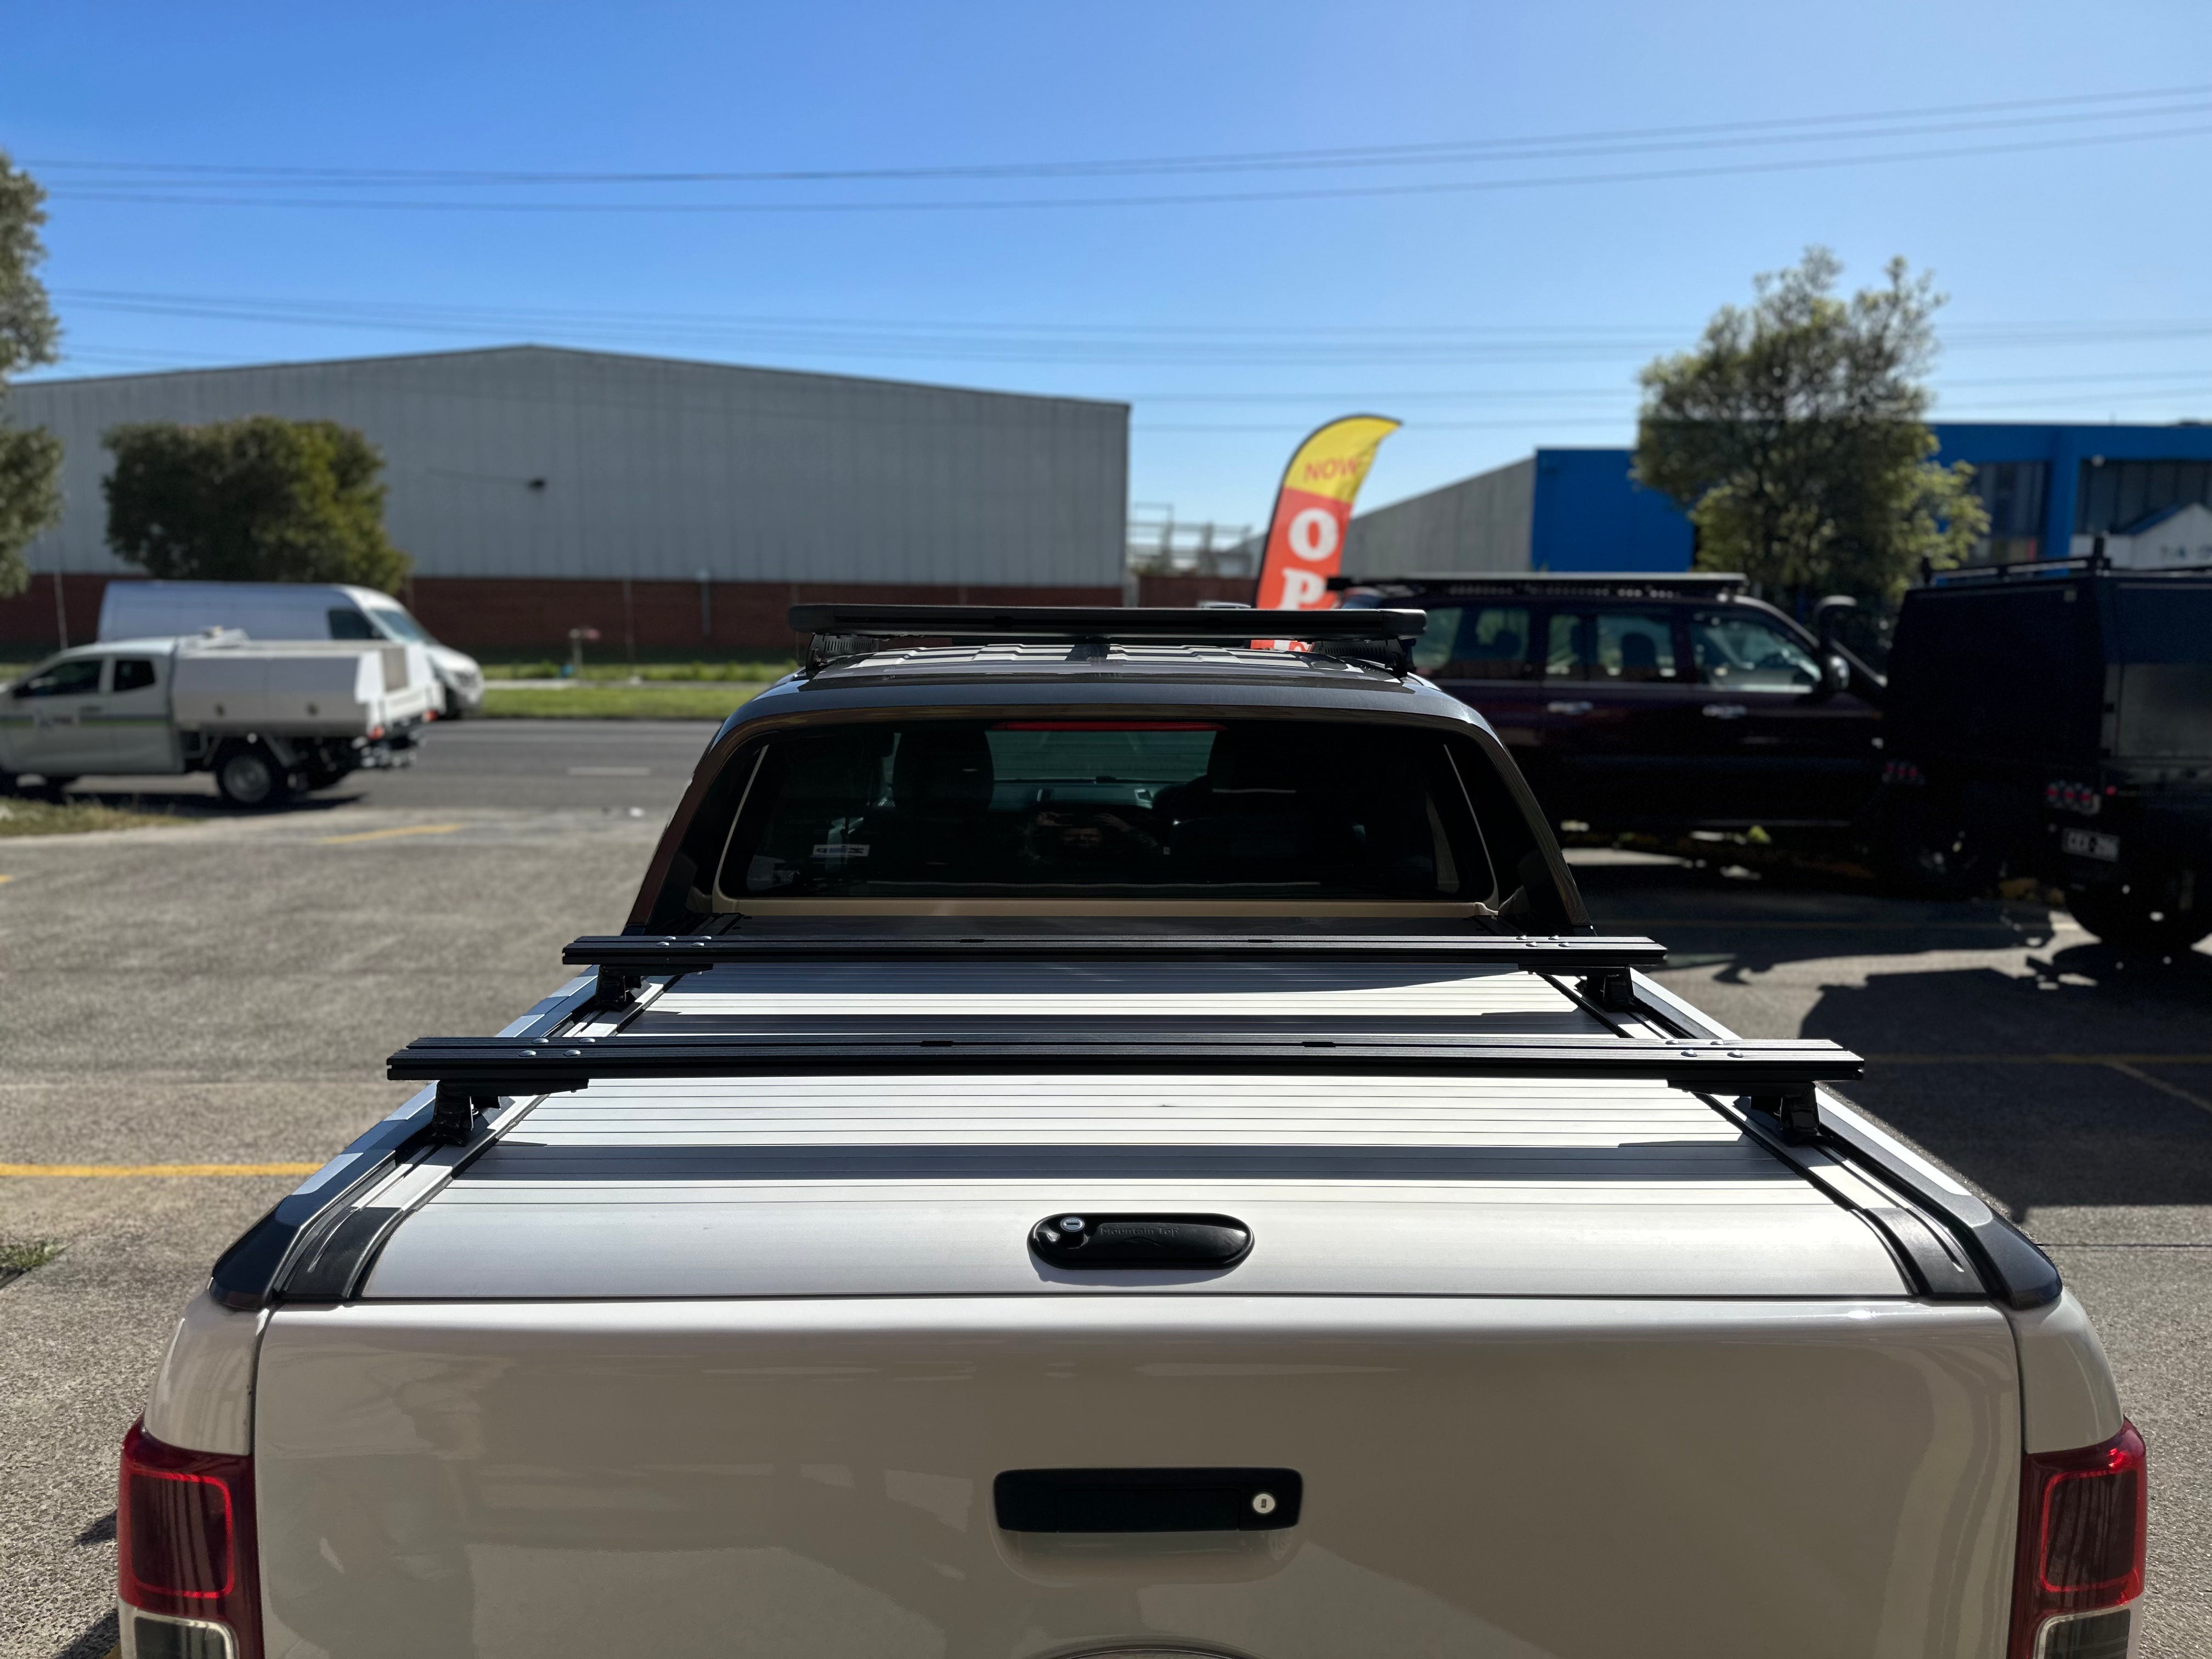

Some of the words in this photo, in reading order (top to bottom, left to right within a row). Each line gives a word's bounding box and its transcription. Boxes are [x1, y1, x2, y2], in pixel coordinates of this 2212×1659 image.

[1304, 458, 1359, 481] NOW
[1275, 507, 1339, 651] OP
[1100, 1226, 1154, 1235] Mountain
[1156, 1226, 1182, 1237] Top
